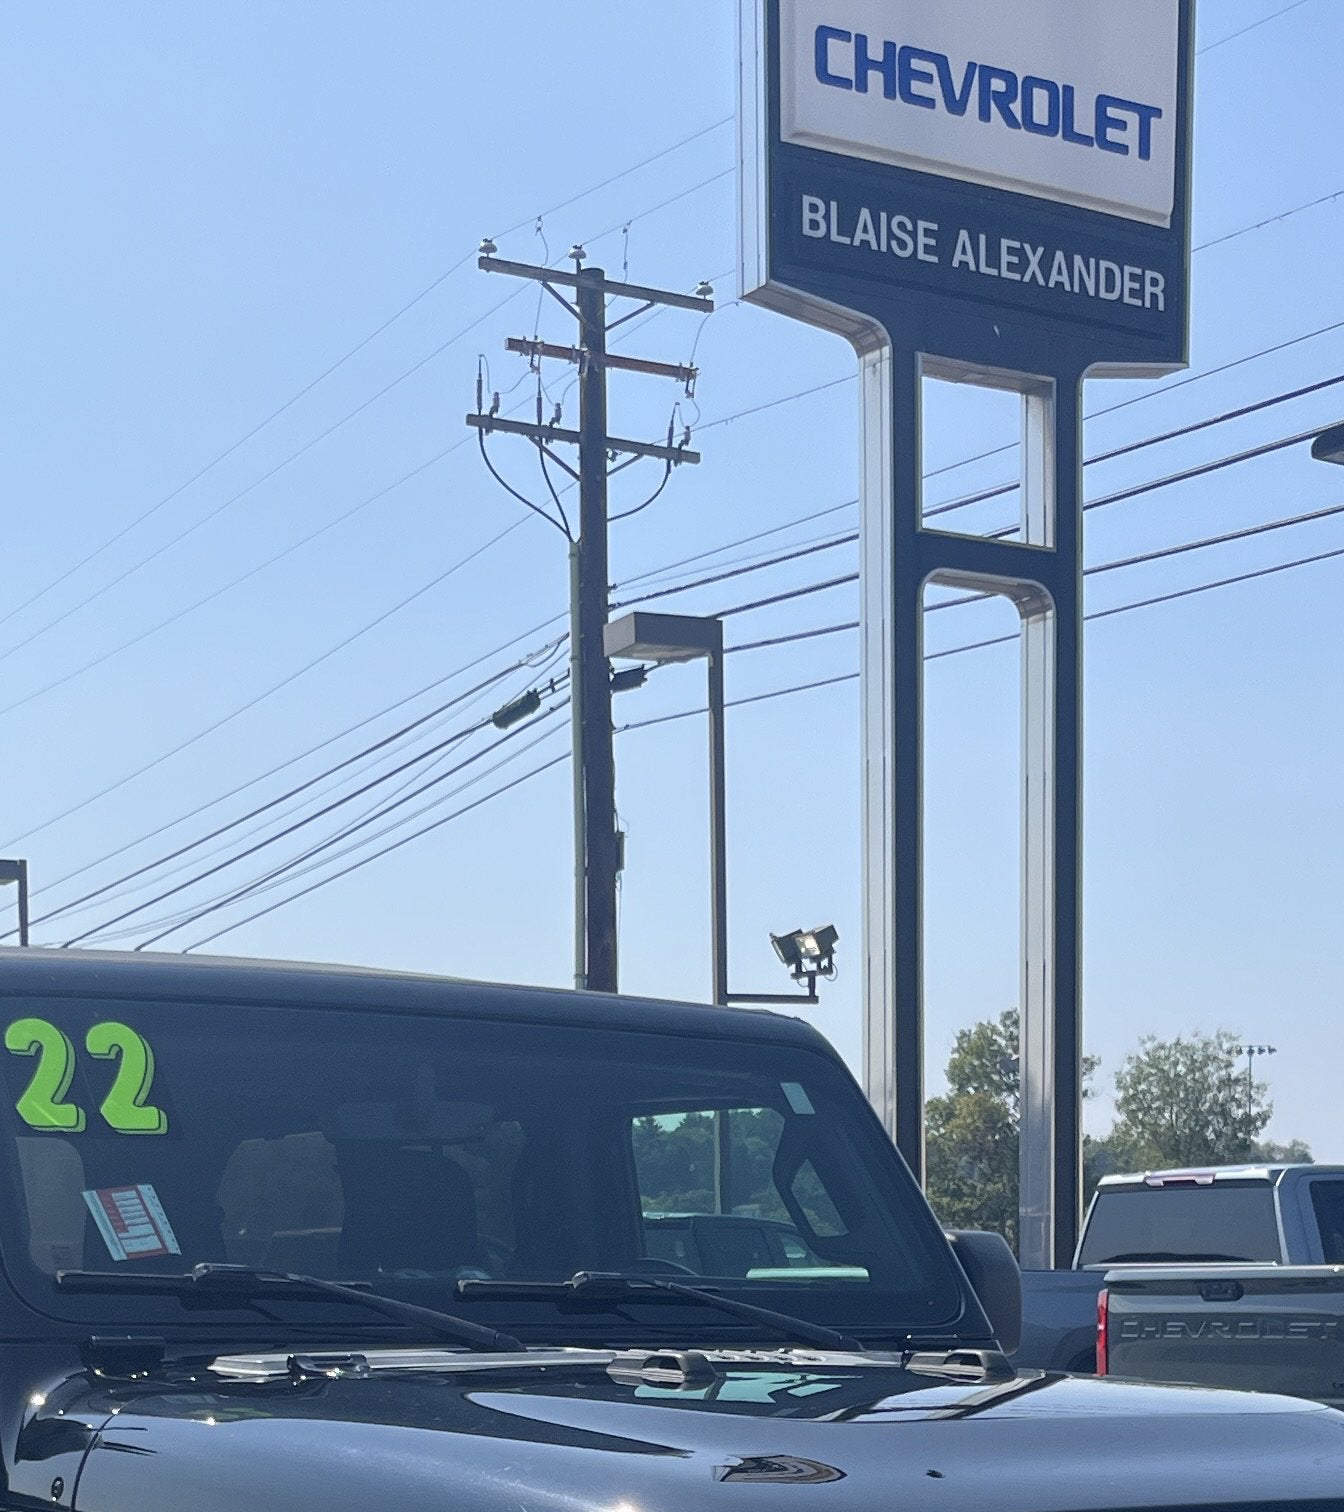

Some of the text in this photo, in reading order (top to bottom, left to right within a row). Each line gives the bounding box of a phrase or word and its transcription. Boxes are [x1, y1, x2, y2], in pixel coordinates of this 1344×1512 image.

[814, 24, 1163, 161] CHEVROLET
[802, 194, 1166, 312] BLAISE ALEXANDER
[4, 1017, 169, 1135] 22
[1120, 1320, 1339, 1339] CHEVROLET
